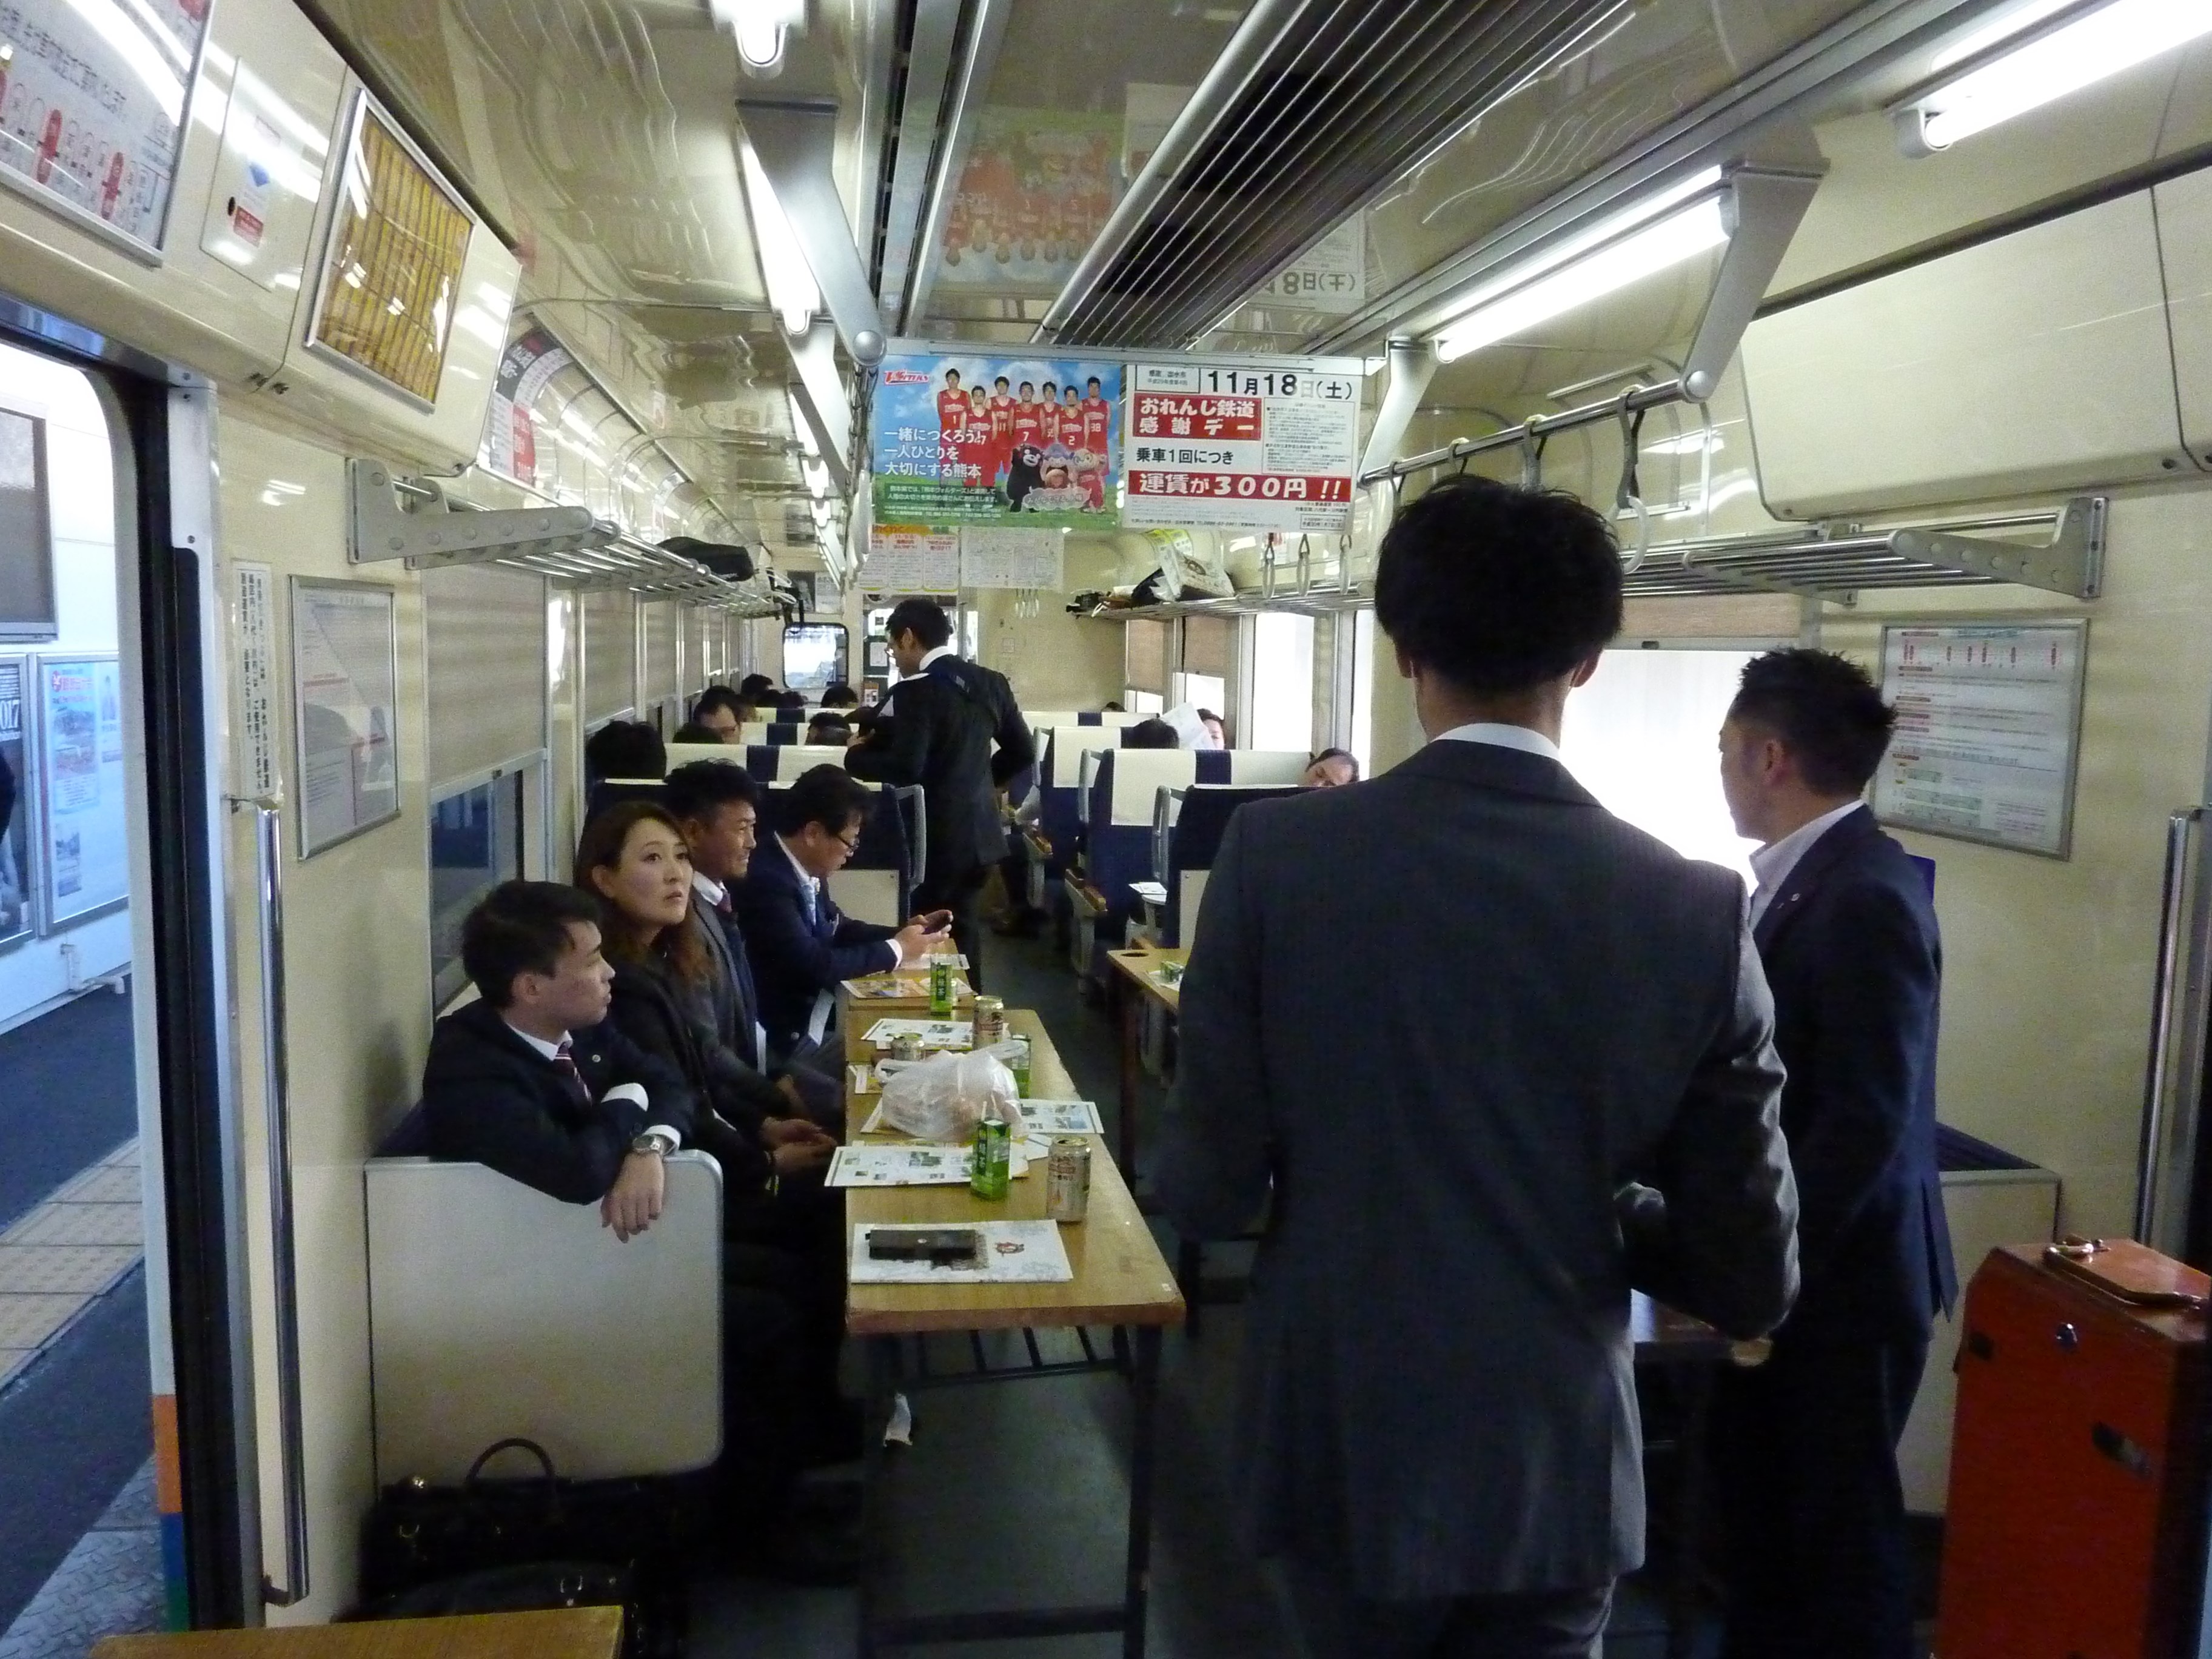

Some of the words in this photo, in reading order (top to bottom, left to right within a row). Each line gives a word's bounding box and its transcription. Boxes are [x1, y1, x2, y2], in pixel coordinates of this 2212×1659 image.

[1208, 370, 1353, 400] 11月18日(土)
[1140, 398, 1256, 418] おれんじ鉄道
[1139, 417, 1255, 436] 感謝デー
[884, 444, 959, 461] 一人ひとりを
[1136, 447, 1234, 465] 乗車1回につき
[884, 463, 982, 479] 大切にする熊本
